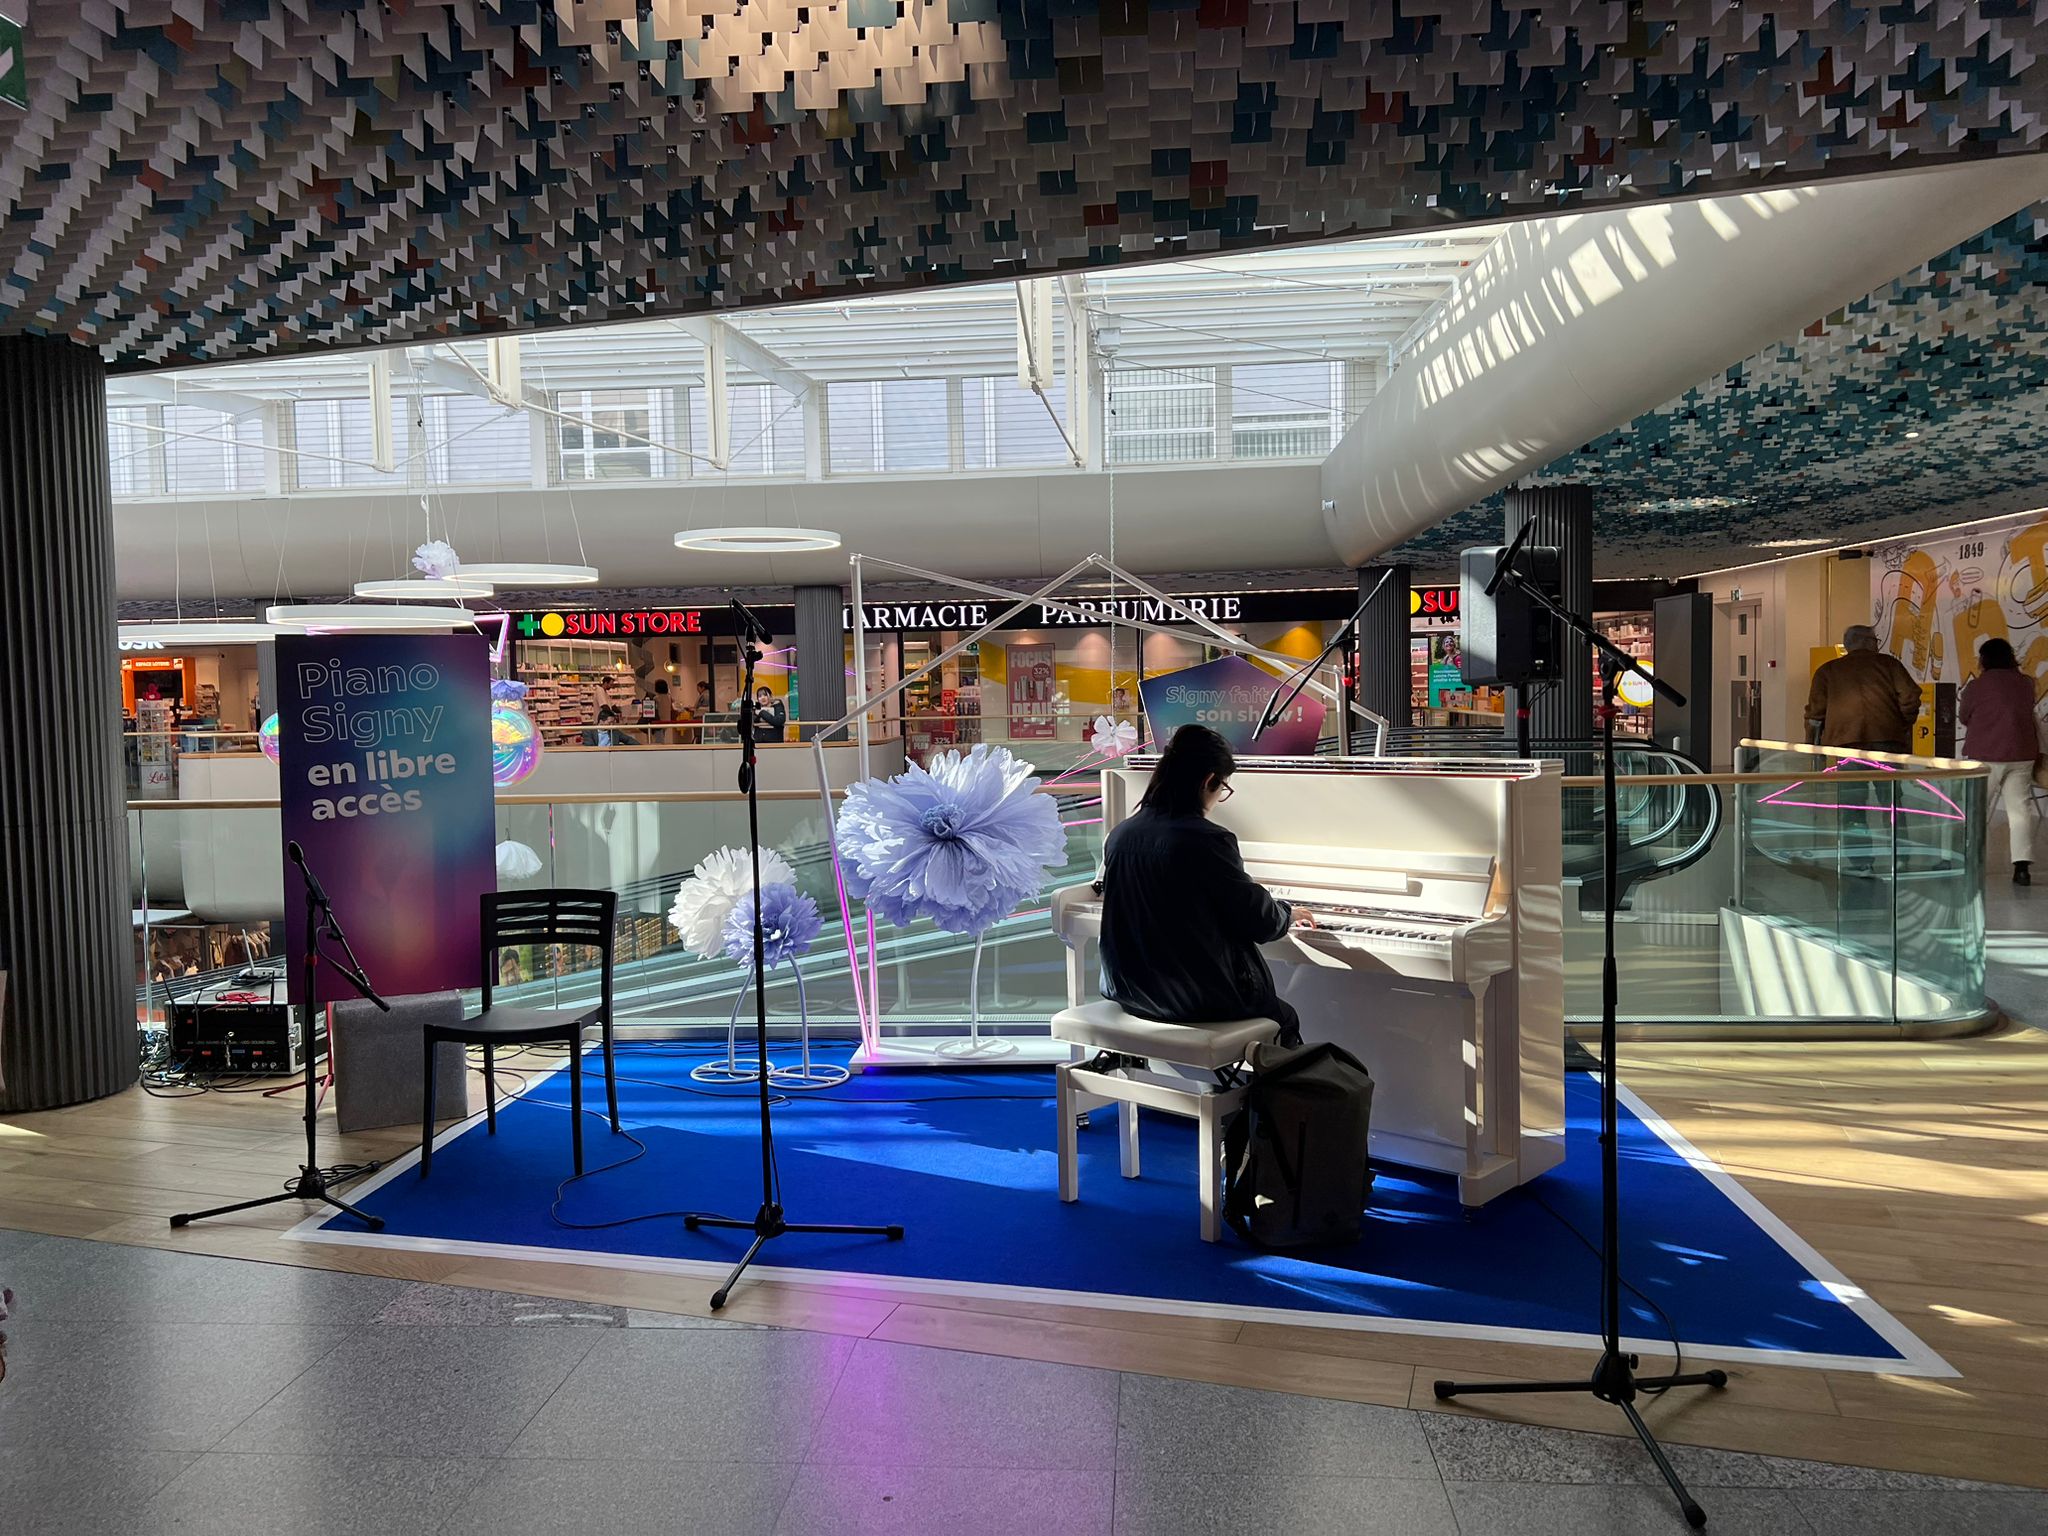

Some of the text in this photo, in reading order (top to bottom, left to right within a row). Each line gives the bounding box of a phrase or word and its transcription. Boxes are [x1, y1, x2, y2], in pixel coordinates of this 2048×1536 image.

[1959, 541, 1984, 560] 1849
[1040, 597, 1241, 624] PARFUMERIE
[1423, 591, 1461, 612] SU
[566, 612, 701, 635] SUN STORE
[1010, 650, 1051, 668] FOCUS
[297, 658, 439, 699] Piano
[1165, 685, 1269, 707] Signy fait
[302, 702, 443, 748] Signy
[1195, 709, 1232, 722] son
[1238, 705, 1293, 722] shw
[307, 749, 456, 787] en libre
[311, 784, 423, 821] accès
